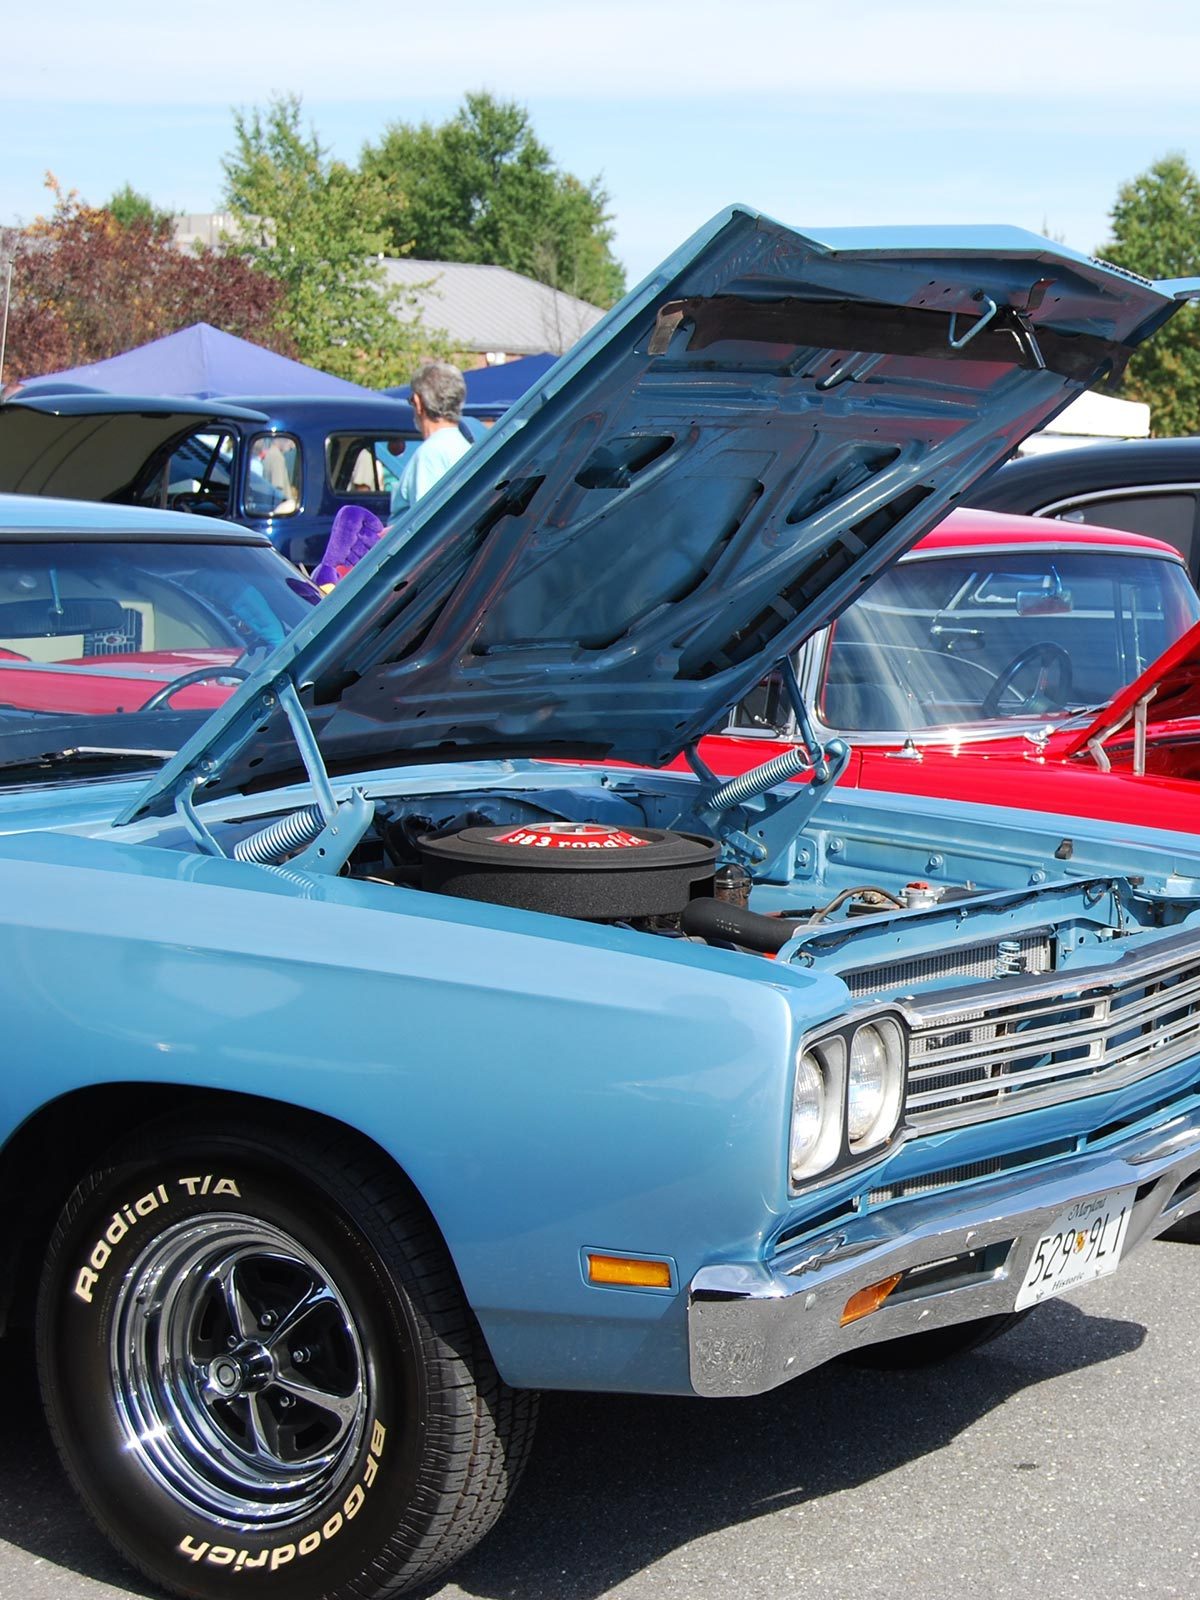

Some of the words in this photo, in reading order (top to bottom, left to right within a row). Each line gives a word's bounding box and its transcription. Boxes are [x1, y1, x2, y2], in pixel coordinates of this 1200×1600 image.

[508, 832, 552, 847] 383
[1068, 1196, 1108, 1220] Maryland
[74, 1184, 169, 1303] Radial
[179, 1175, 242, 1198] T/A
[1028, 1228, 1076, 1287] 529
[1051, 1272, 1085, 1291] Historic
[179, 1419, 387, 1572] BFGoodrich
